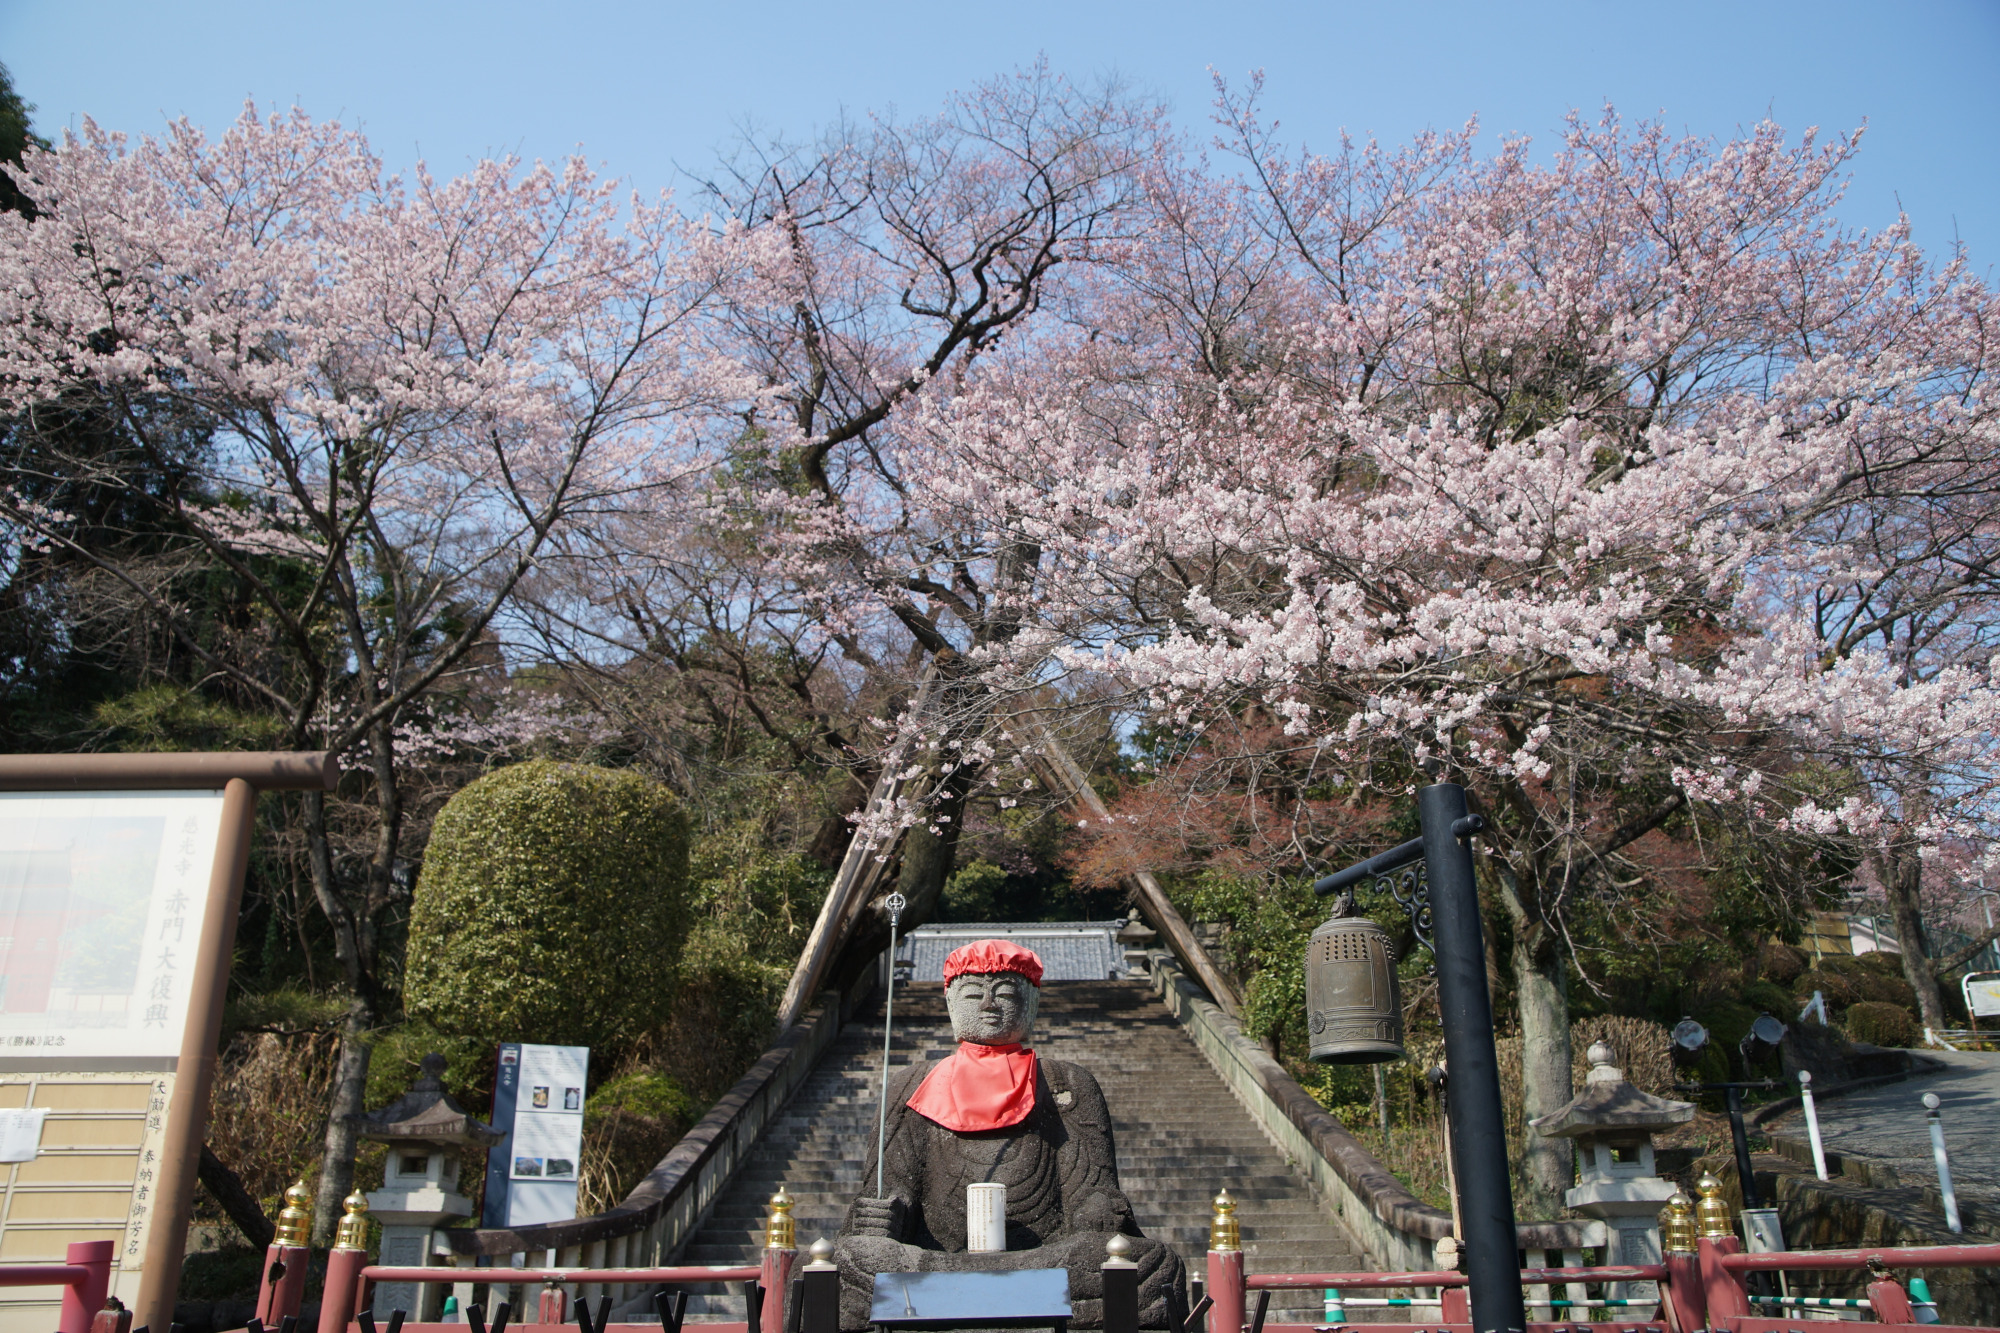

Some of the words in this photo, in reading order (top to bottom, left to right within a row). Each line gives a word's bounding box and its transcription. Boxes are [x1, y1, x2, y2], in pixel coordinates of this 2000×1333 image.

[174, 815, 199, 877] 慈光寺
[143, 888, 190, 1029] 赤門大復興
[128, 1149, 155, 1255] 奉納者御芳名
